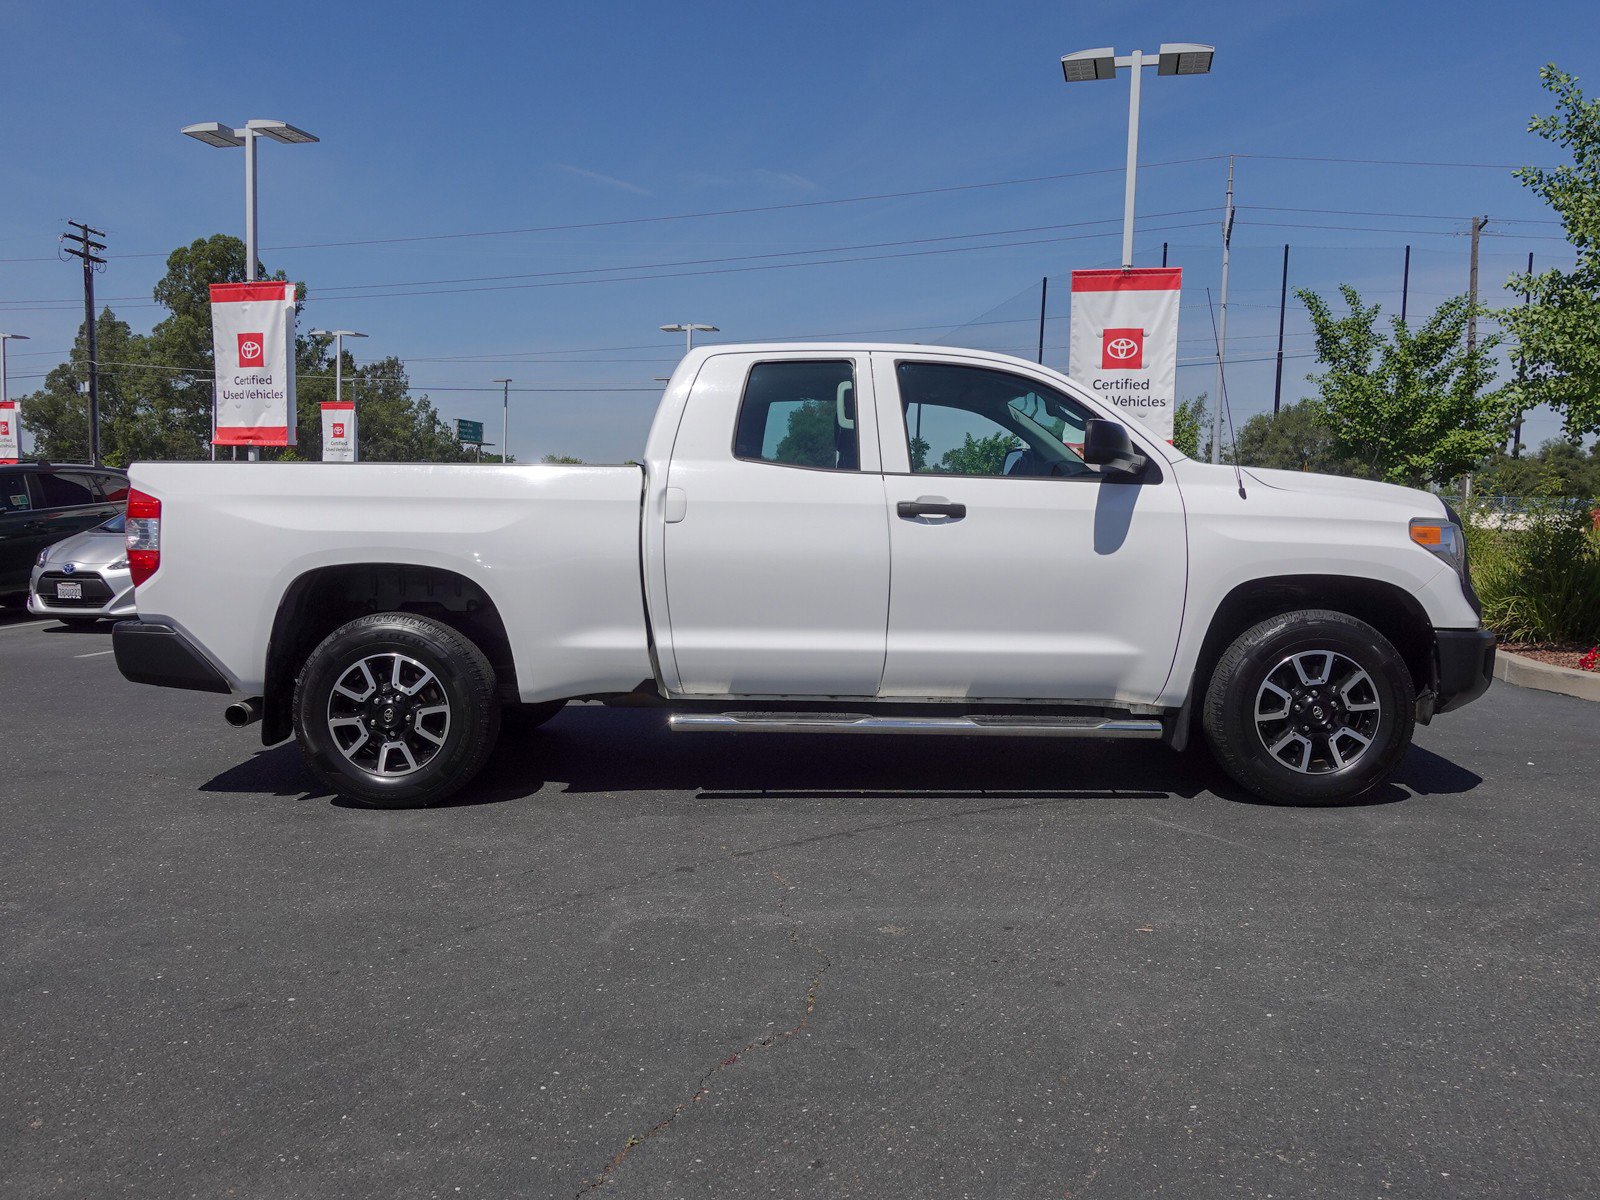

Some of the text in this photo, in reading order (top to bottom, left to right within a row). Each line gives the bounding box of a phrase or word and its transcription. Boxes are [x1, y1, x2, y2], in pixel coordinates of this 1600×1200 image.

[234, 375, 272, 386] Certified
[1092, 378, 1150, 390] Certified
[223, 389, 284, 400] Used Vehicles
[1111, 395, 1166, 407] Vehicles
